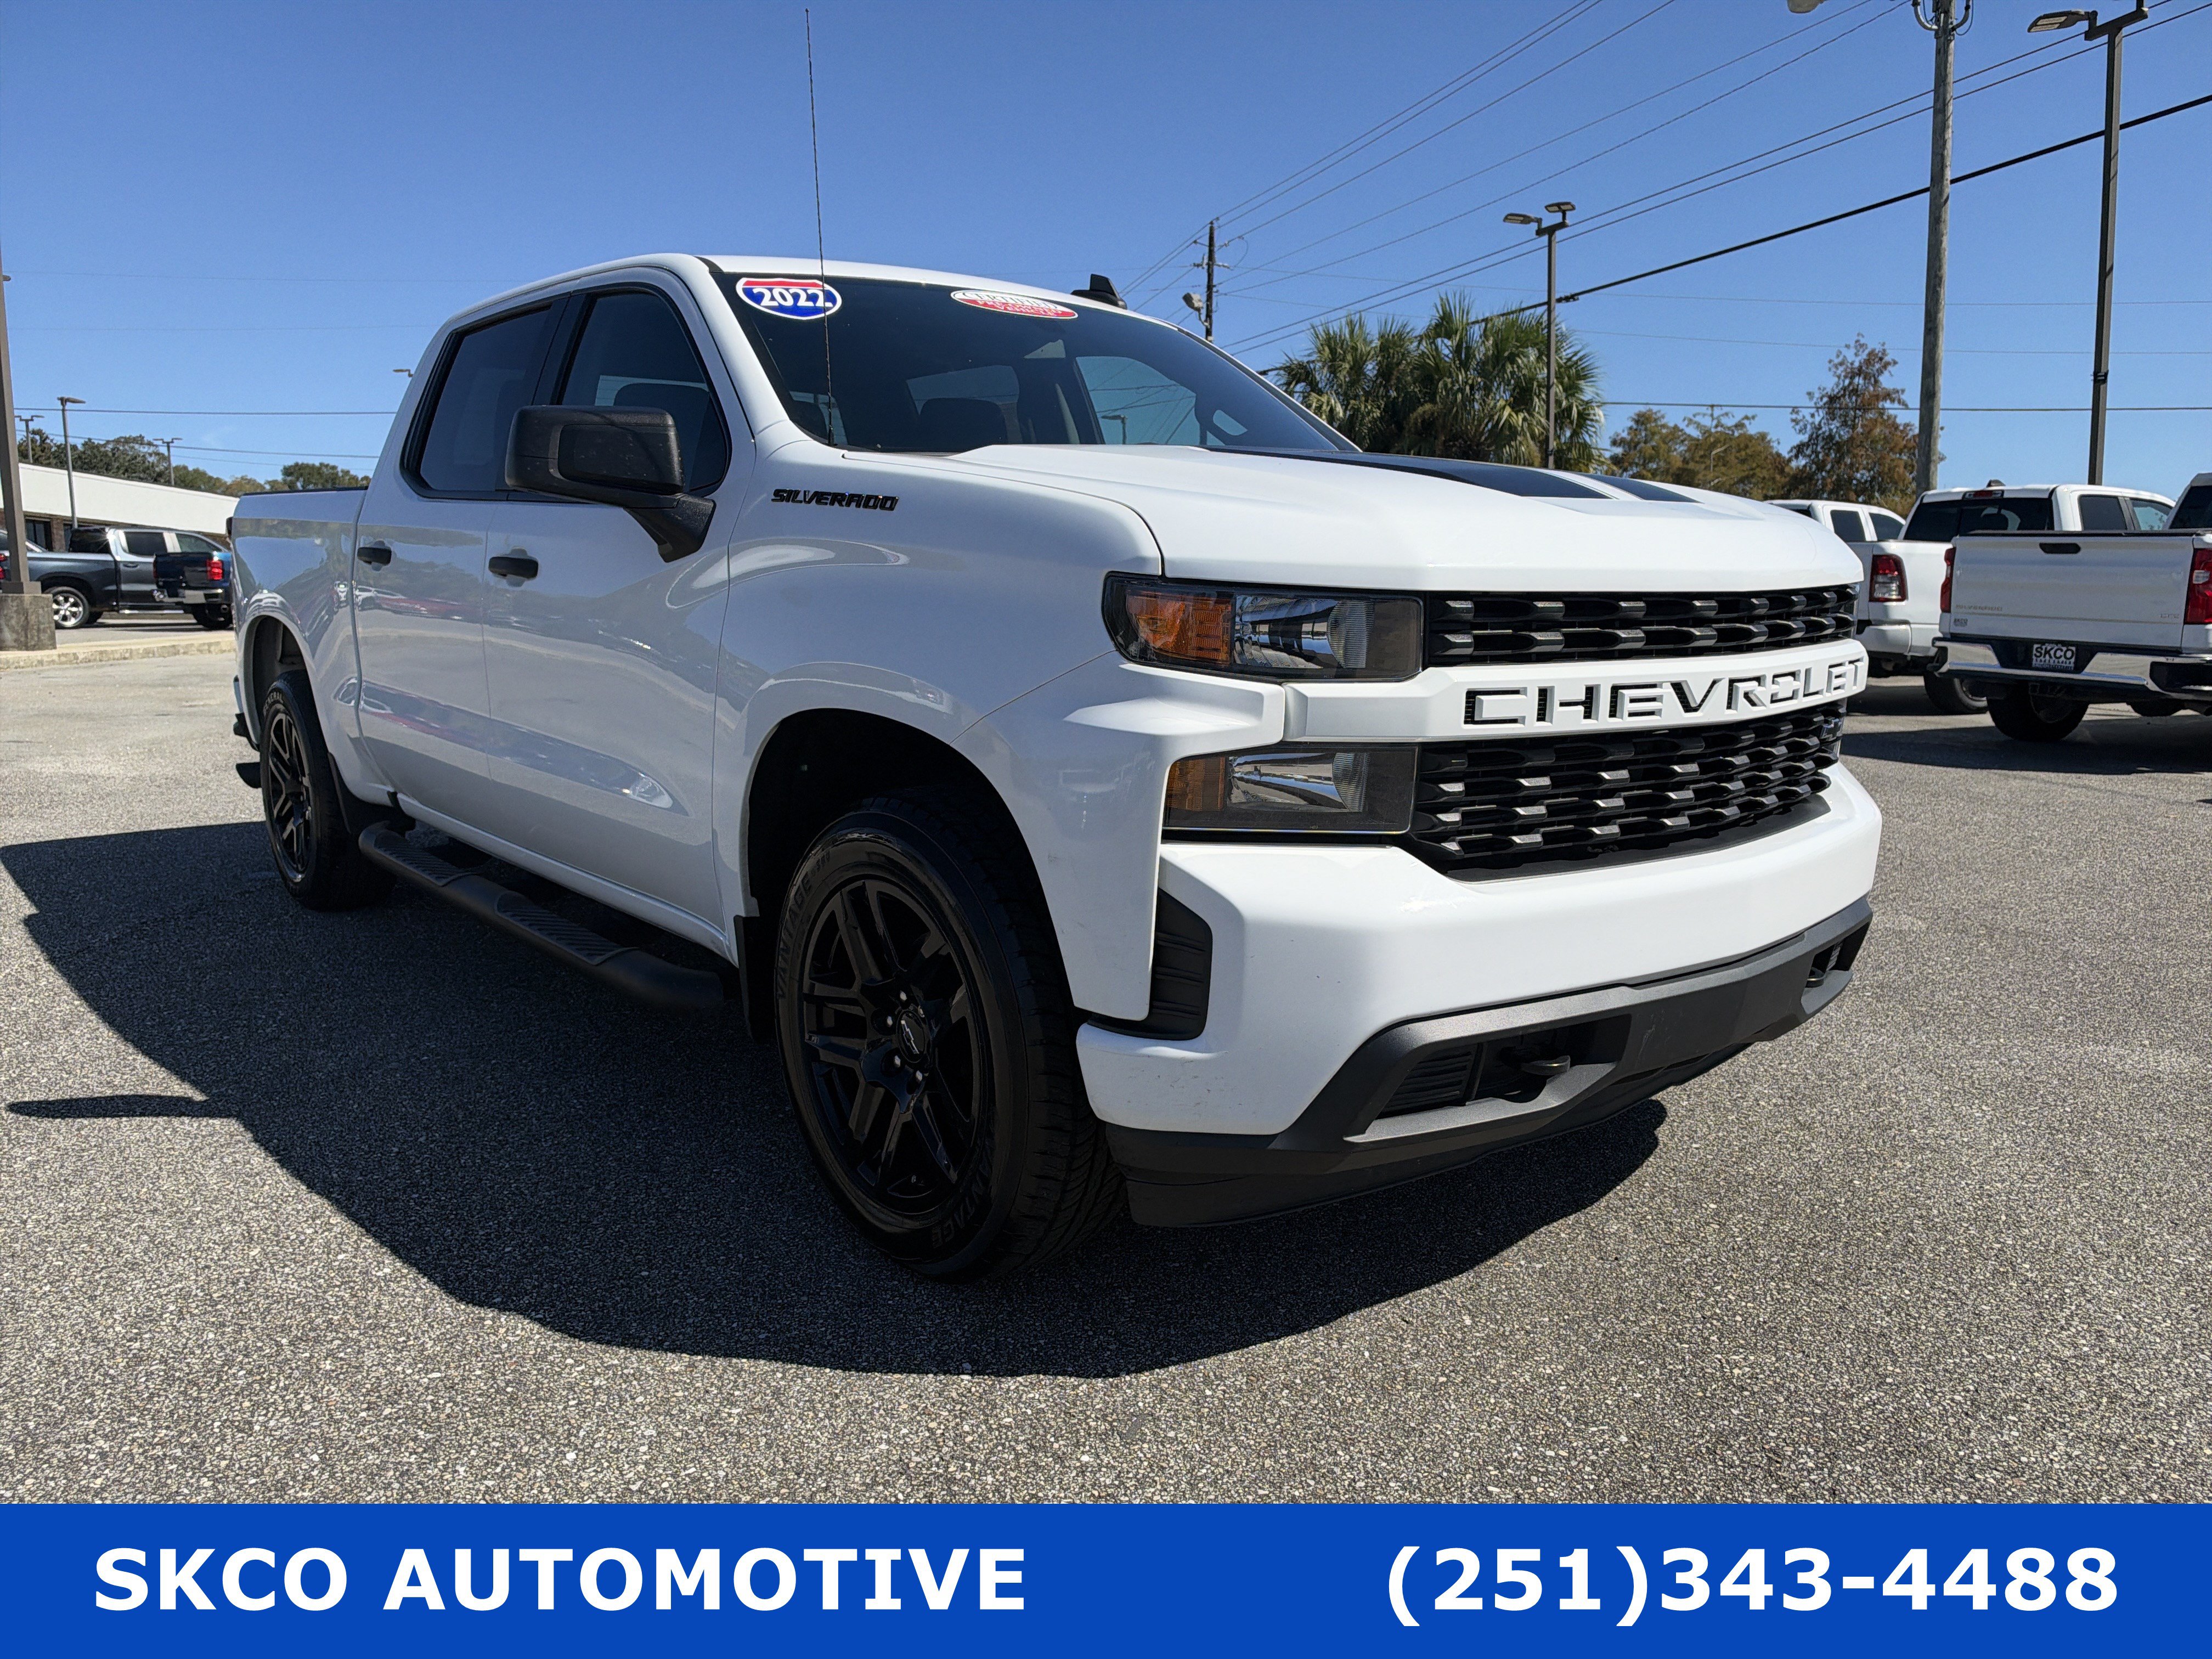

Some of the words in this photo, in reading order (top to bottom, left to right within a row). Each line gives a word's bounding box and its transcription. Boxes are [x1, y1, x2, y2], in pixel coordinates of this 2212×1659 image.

[753, 287, 833, 307] 2022
[771, 488, 899, 511] SILVERADO
[2034, 646, 2075, 660] SKCO
[1463, 658, 1865, 726] CHEVROLET
